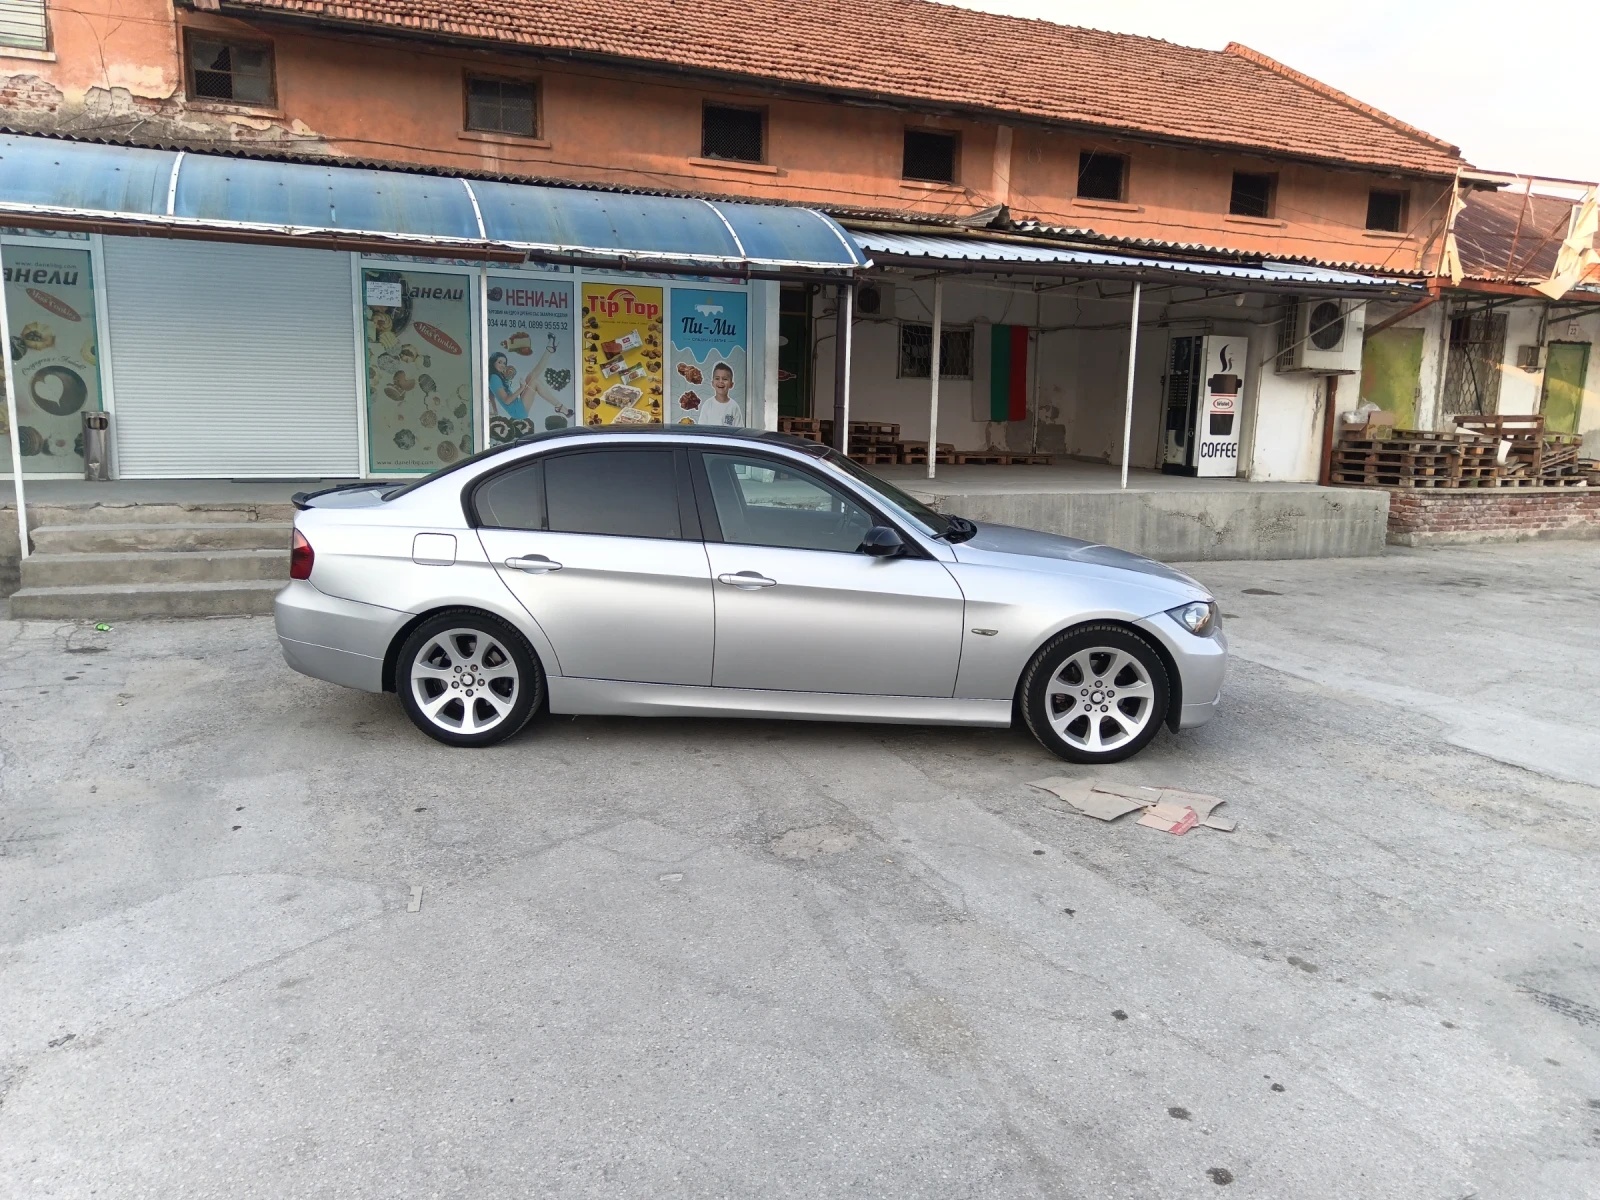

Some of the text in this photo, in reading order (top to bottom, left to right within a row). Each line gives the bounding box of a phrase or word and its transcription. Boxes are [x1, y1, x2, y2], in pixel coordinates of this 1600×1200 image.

[3, 267, 79, 286] анели
[505, 288, 568, 309] НЕНИ-АН
[587, 295, 659, 320] Tip Top
[681, 316, 737, 336] Пи-Ми
[419, 323, 459, 353] Miss Cookies
[1200, 442, 1237, 458] COFFEE
